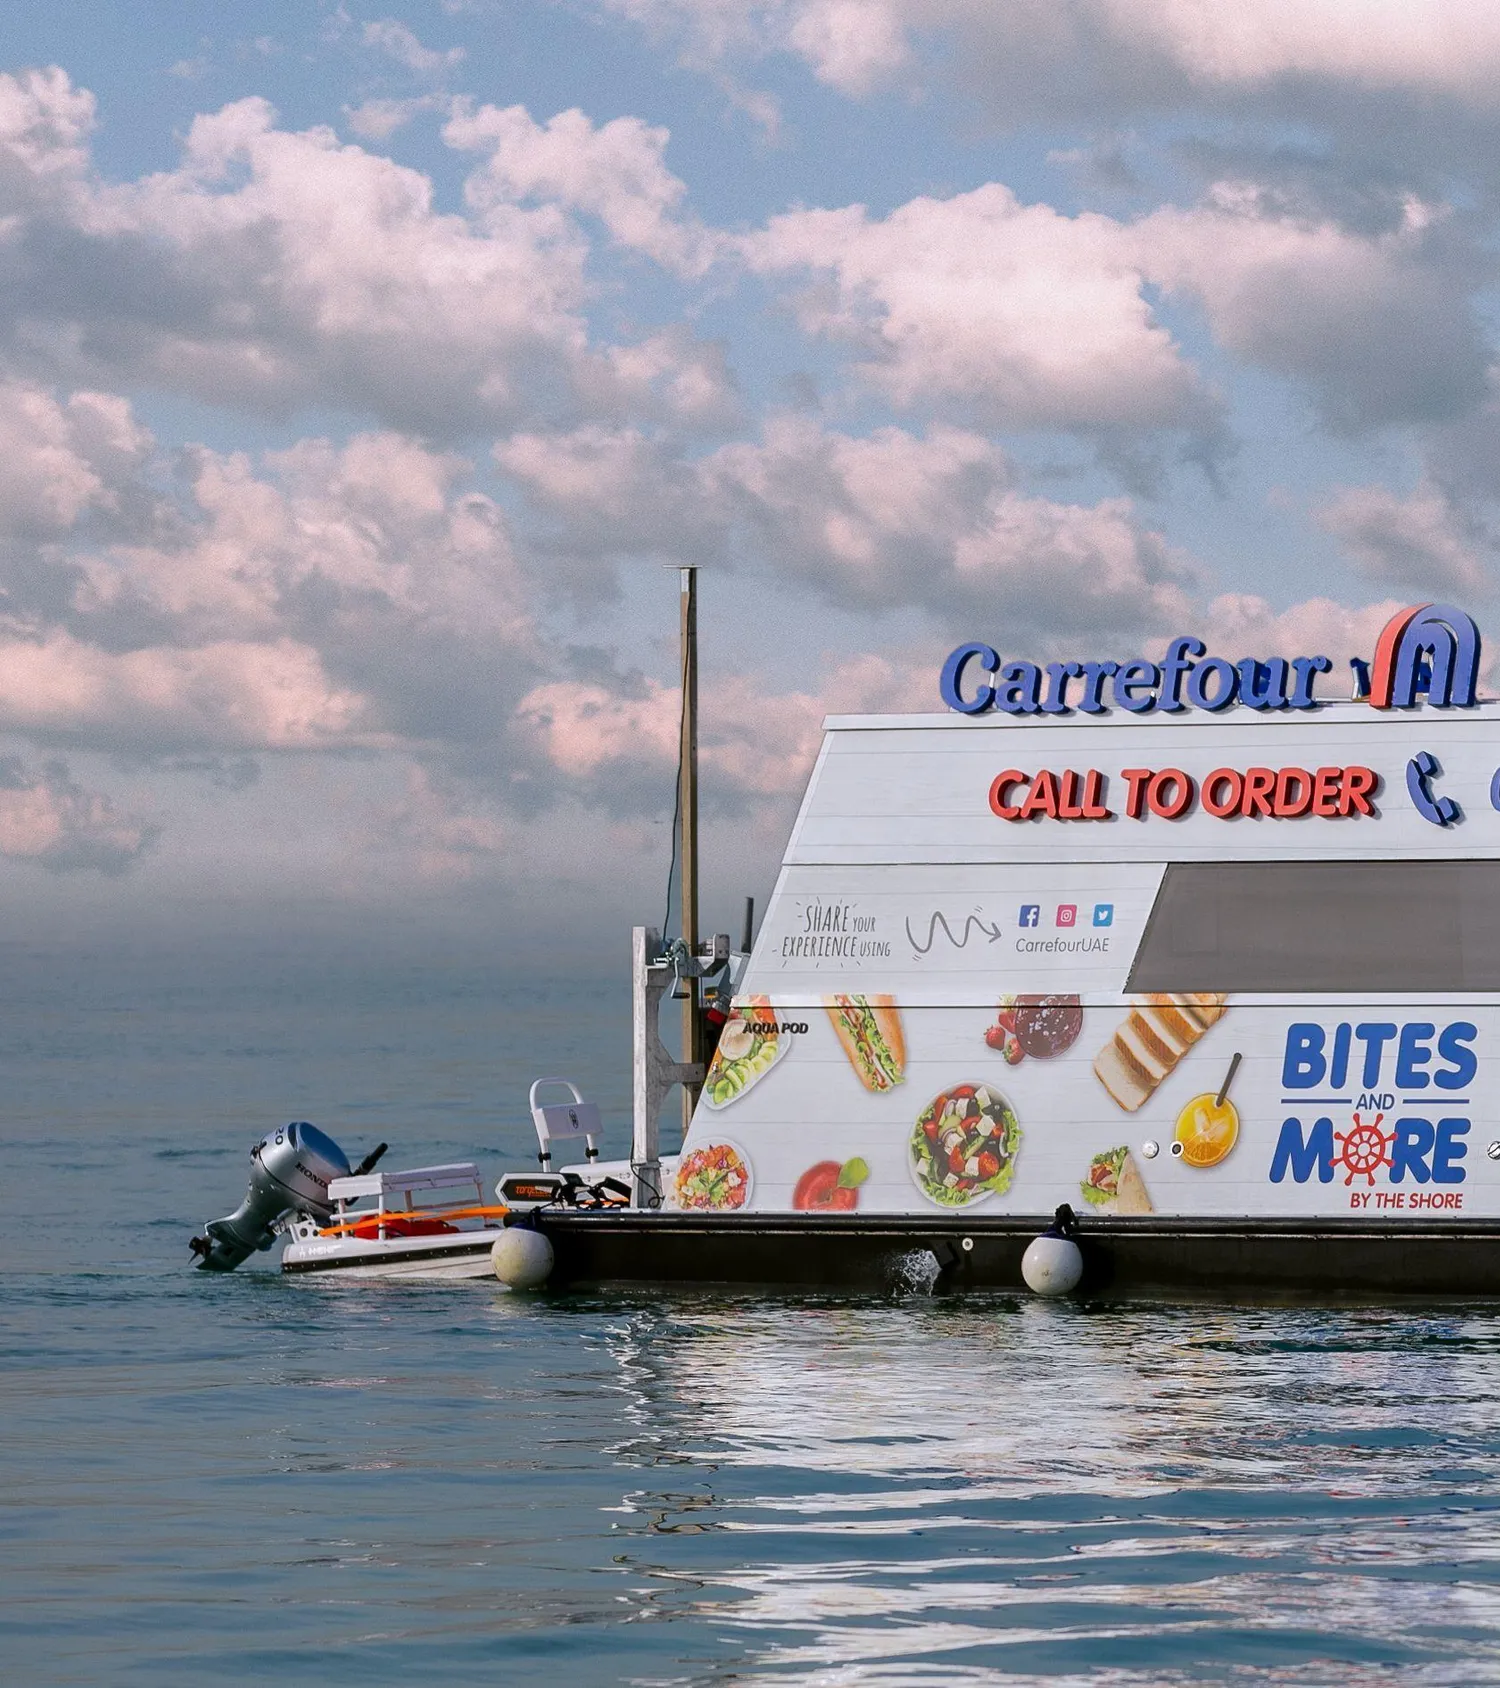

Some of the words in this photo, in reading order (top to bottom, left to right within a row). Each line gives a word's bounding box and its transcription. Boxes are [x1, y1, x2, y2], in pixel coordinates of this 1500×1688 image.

[940, 636, 1332, 713] Carrefour
[988, 768, 1112, 820] CALL
[1121, 767, 1195, 819] TO
[1200, 765, 1382, 819] ORDER
[804, 905, 850, 933] SHARE
[852, 916, 876, 933] YOUR
[782, 936, 858, 957] EXPERIENCE
[860, 941, 891, 957] USING
[1016, 937, 1109, 952] CarrefourUAE
[743, 1021, 779, 1035] AQUA
[781, 1021, 809, 1035] POD
[1281, 1021, 1478, 1090] BITES
[1355, 1093, 1395, 1110] AND
[295, 1161, 328, 1191] HOND
[1350, 1193, 1373, 1209] BY
[1375, 1193, 1405, 1209] THE
[1408, 1193, 1464, 1209] SHORE
